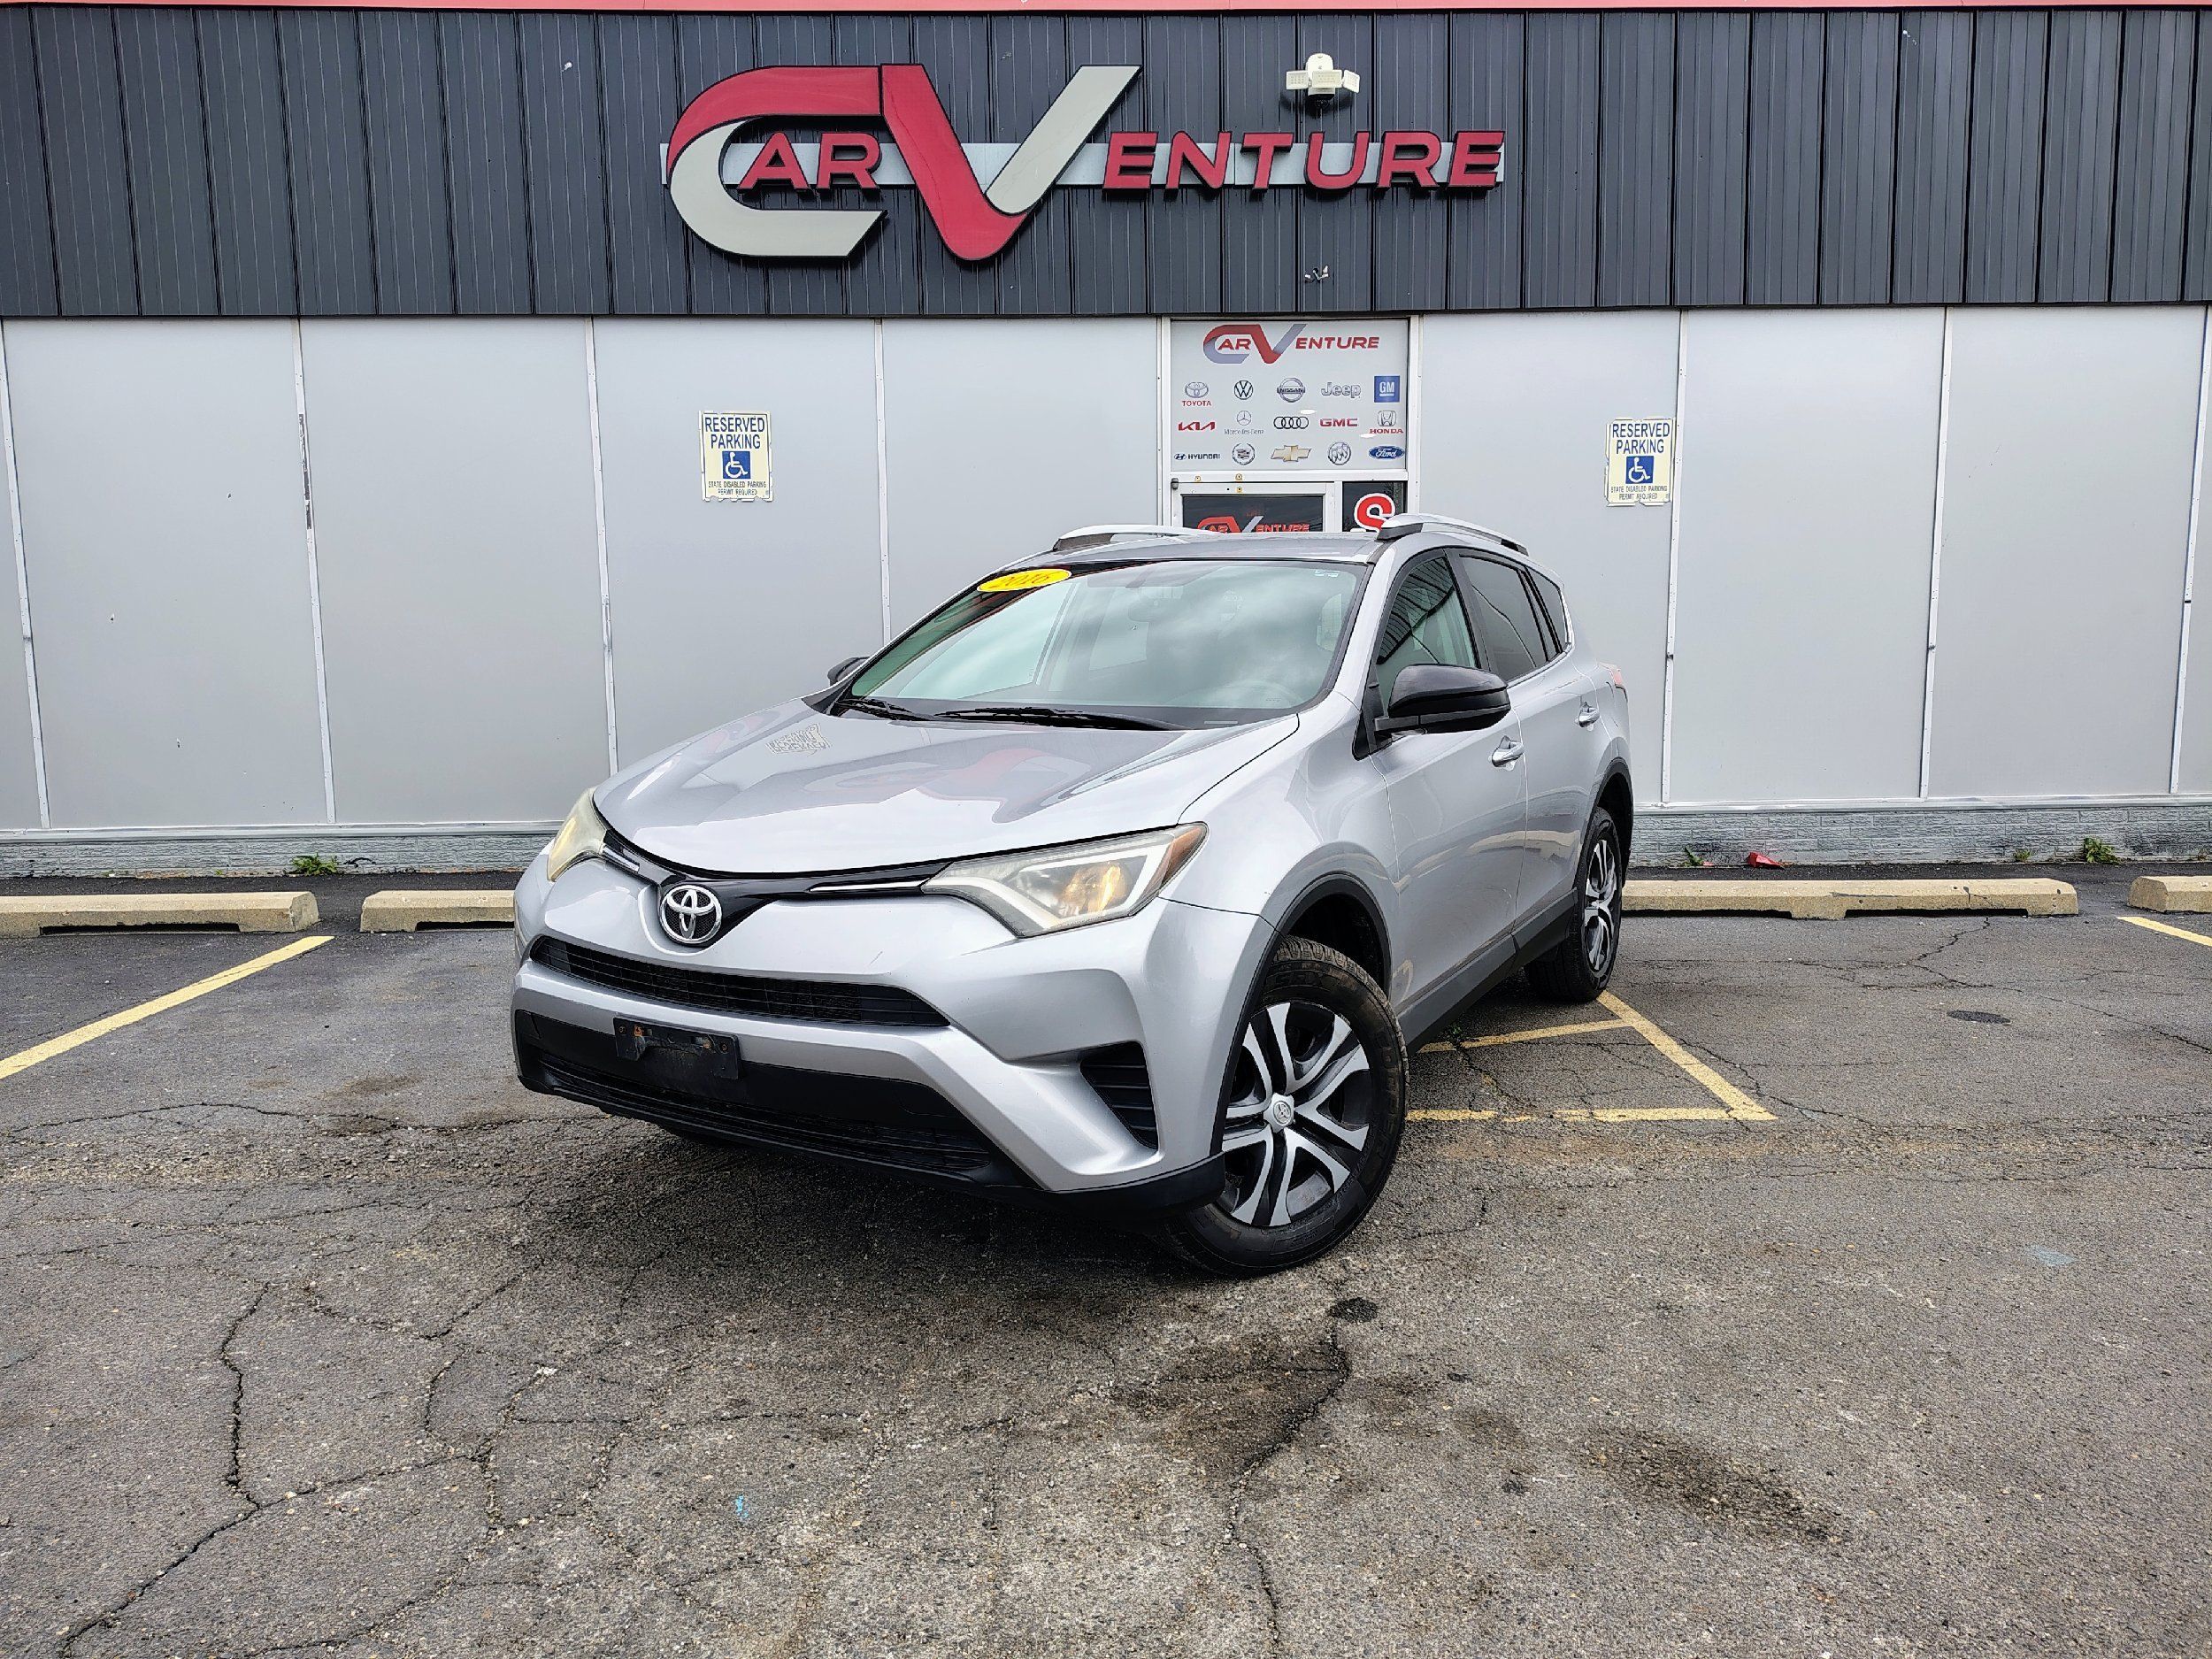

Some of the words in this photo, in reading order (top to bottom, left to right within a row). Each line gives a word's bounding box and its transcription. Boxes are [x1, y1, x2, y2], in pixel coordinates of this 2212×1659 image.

[1320, 381, 1362, 399] Jeep
[1379, 381, 1395, 394] GM
[704, 417, 765, 433] RESERVED
[1319, 418, 1358, 427] GMC
[1612, 422, 1671, 438] RESERVED
[710, 434, 761, 449] PARKING
[1616, 439, 1664, 455] PARKING
[1374, 448, 1398, 457] Ford
